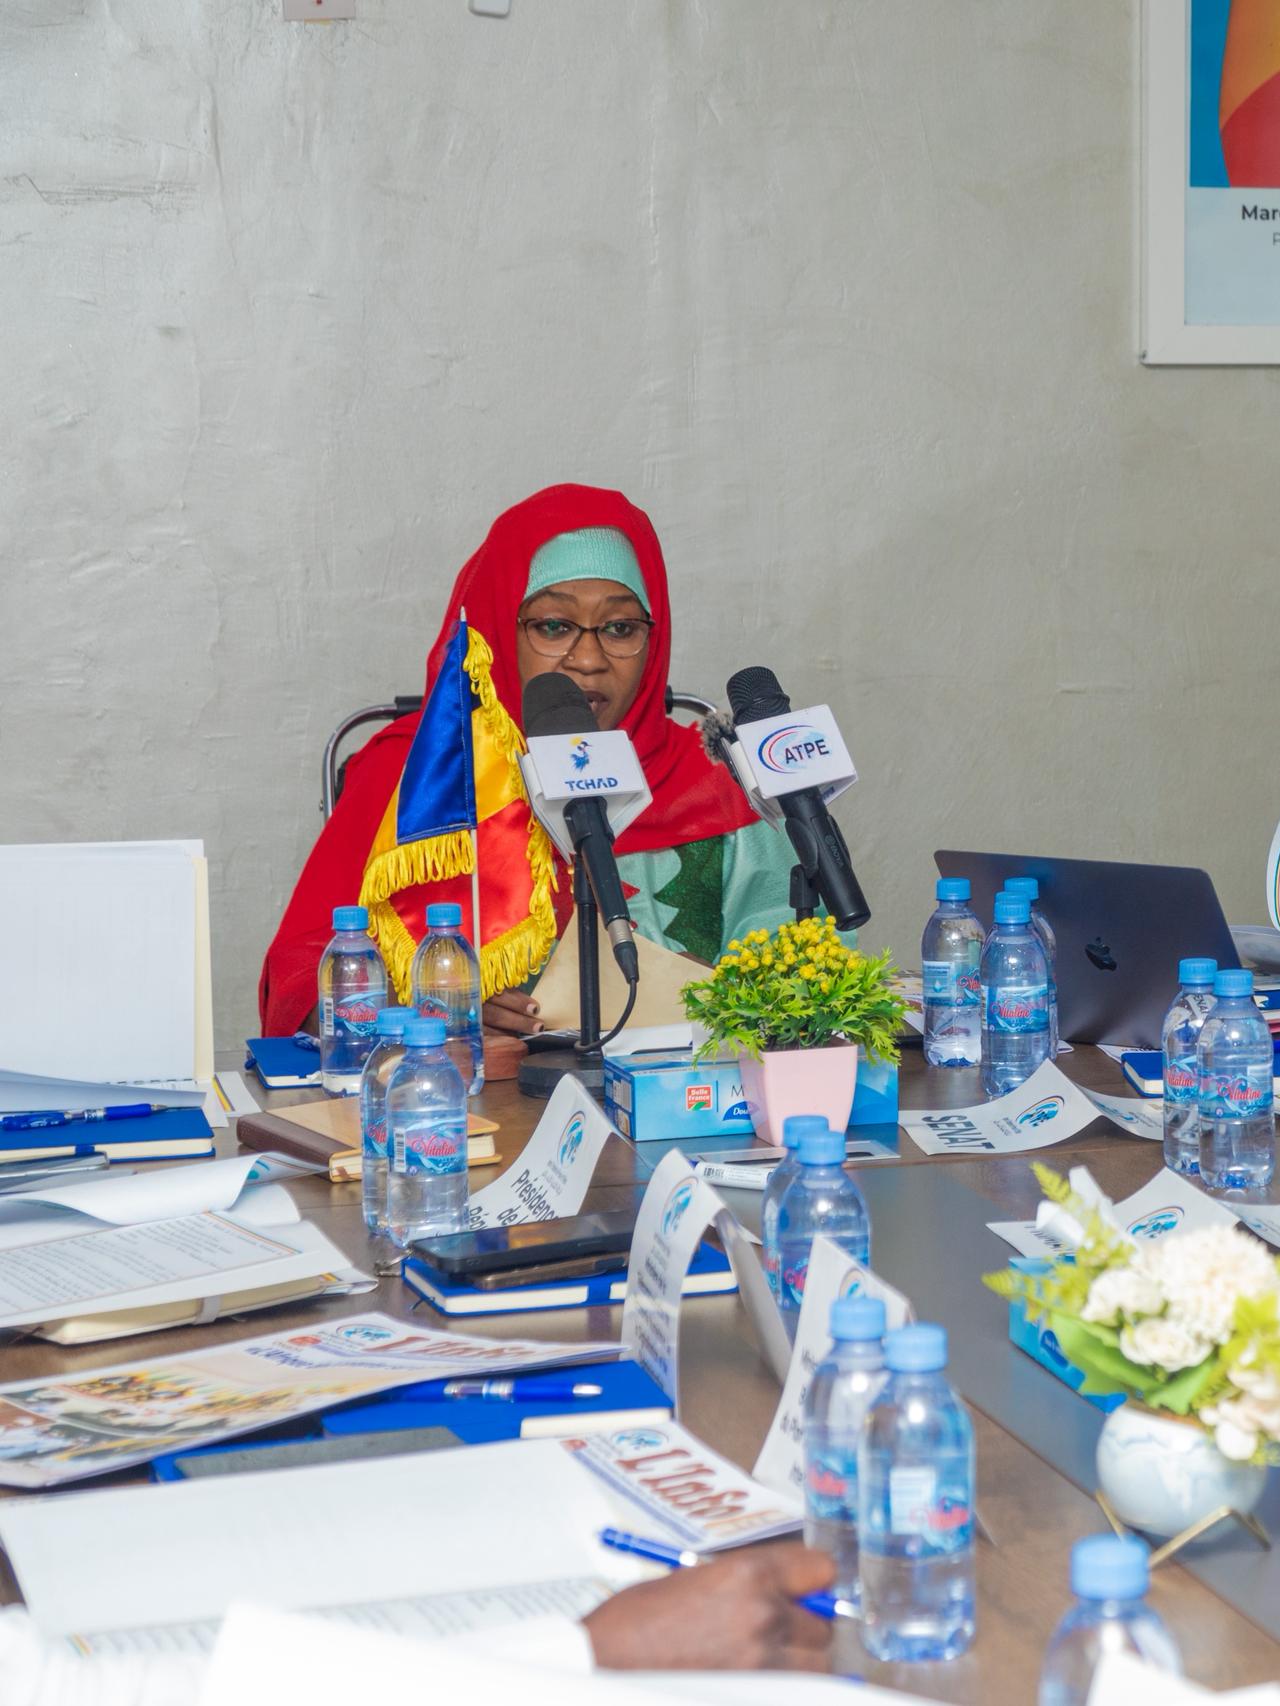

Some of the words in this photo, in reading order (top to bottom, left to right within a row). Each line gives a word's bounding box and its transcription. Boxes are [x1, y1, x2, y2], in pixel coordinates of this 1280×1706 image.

[784, 738, 829, 765] ATPE
[565, 777, 618, 792] TCHAD
[922, 1114, 996, 1150] SENAT
